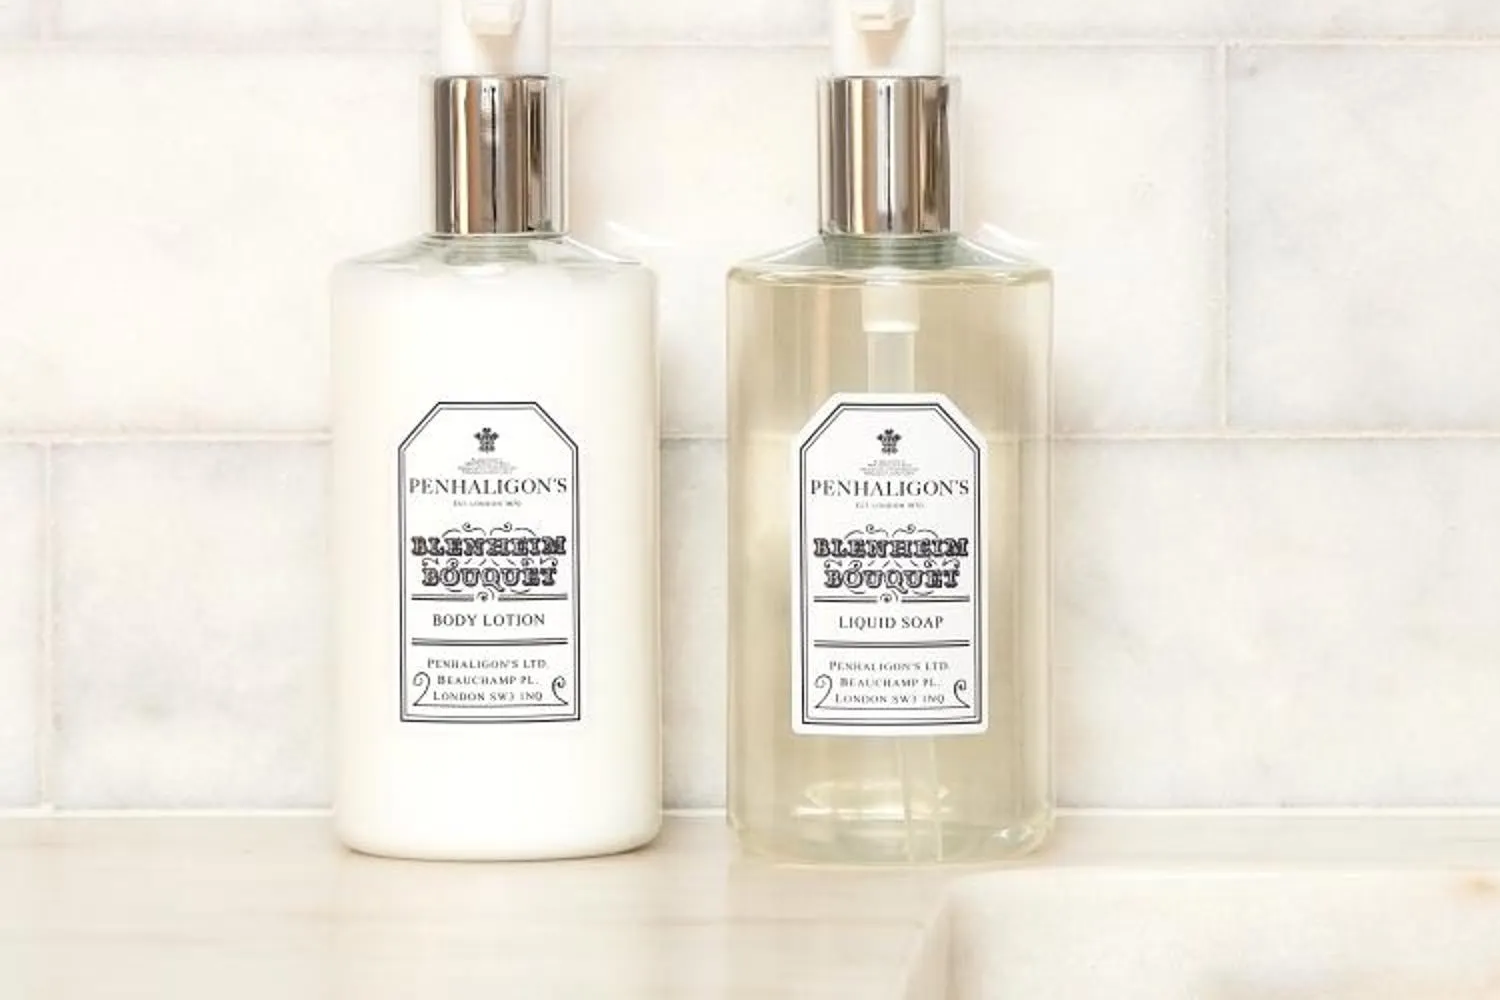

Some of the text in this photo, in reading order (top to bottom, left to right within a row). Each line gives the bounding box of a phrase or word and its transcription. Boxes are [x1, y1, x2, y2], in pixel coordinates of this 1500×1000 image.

[410, 478, 567, 494] PENHALIGON'S
[811, 480, 969, 496] PENHALIGON'S
[411, 536, 567, 556] BLENHEIM
[814, 538, 969, 558] BLENHEIM
[421, 567, 558, 592] BOUQUET
[824, 569, 960, 594] BOUQUET
[433, 614, 544, 626] BODY LOTION
[840, 616, 944, 631] LIQUID SOAP
[428, 658, 518, 668] PENHALIGON'S
[829, 661, 920, 671] PENHALIGON'S
[438, 675, 516, 685] BEAUCHAMP
[840, 678, 918, 687] BEAUCHAMP
[433, 691, 484, 701] LONDON
[836, 694, 887, 703] LONDON
